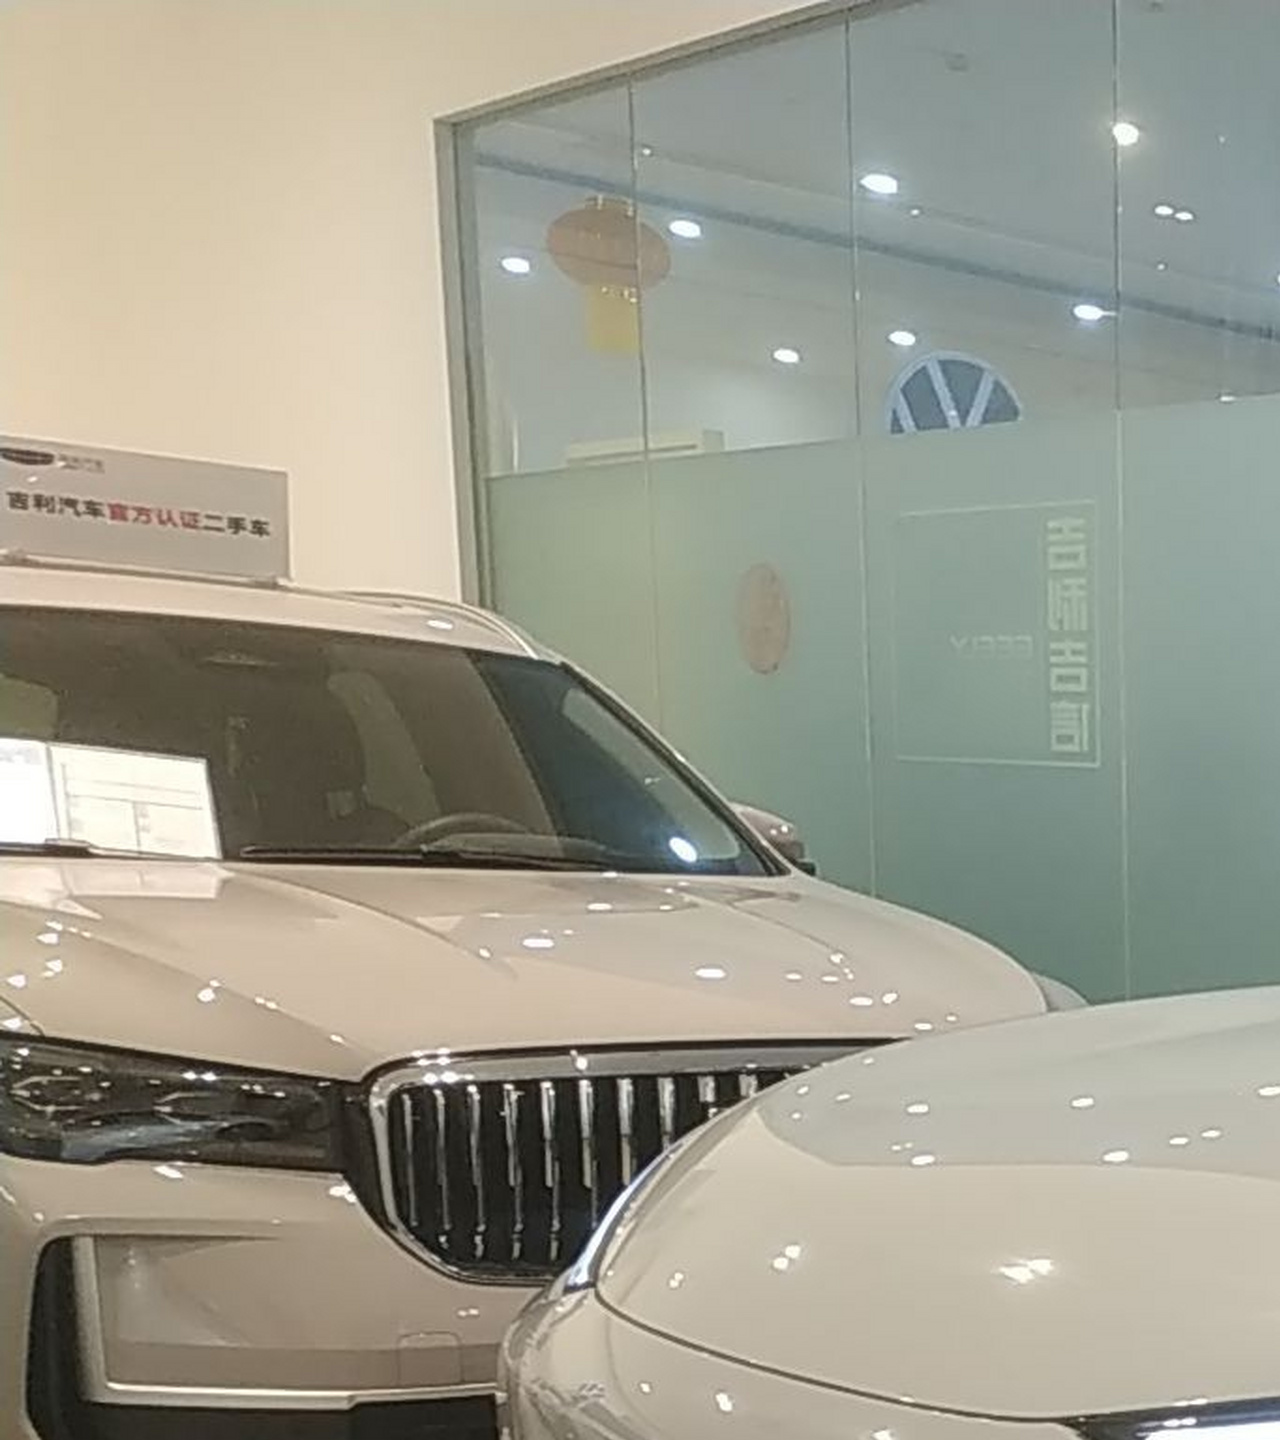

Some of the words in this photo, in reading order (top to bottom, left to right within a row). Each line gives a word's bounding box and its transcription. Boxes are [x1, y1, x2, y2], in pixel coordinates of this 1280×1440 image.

[6, 491, 270, 537] 吉利汽车官方认证二手车
